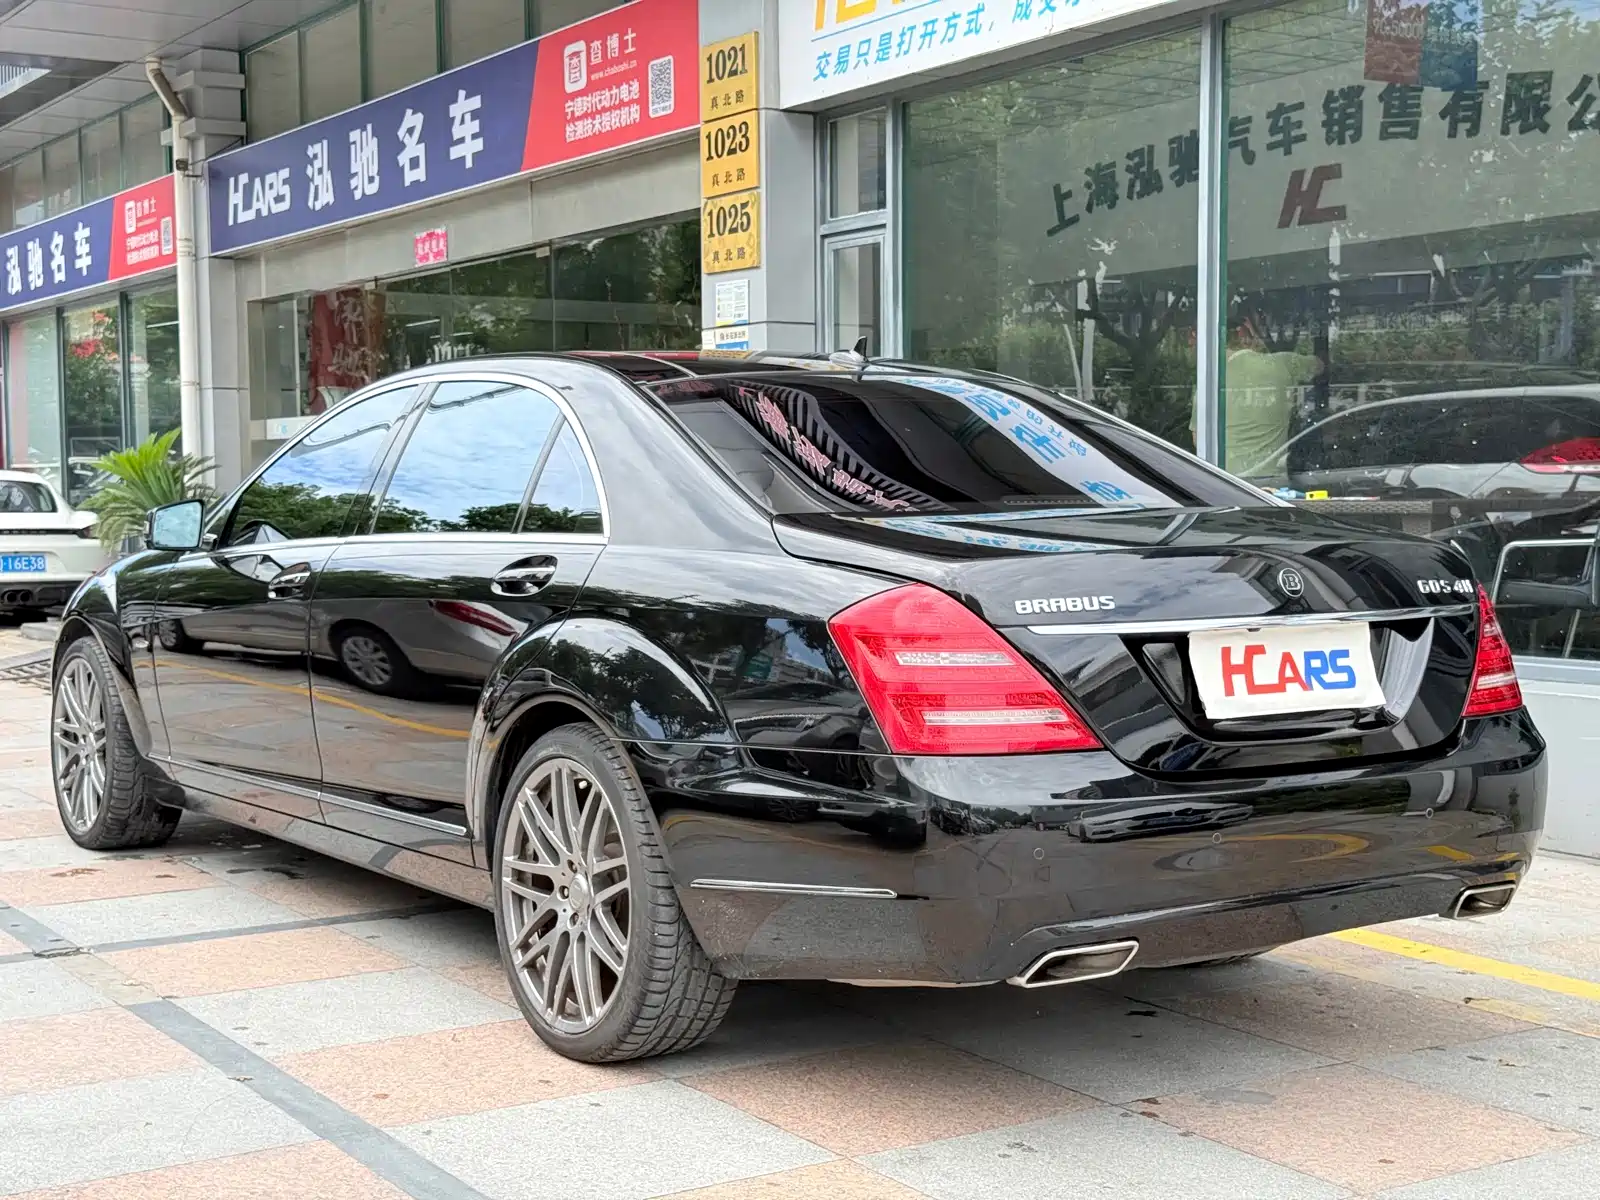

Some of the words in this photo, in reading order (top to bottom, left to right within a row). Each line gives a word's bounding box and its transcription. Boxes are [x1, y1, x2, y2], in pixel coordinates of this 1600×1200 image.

[590, 27, 637, 65] 查博士
[706, 43, 748, 84] 1021
[711, 89, 745, 110] 真北路
[228, 167, 291, 226] HCARS
[305, 88, 485, 212] 泓驰名车
[705, 121, 750, 162] 1023
[711, 168, 746, 188] 真北路
[707, 200, 751, 238] 1025
[6, 221, 92, 295] 泓驰名车
[712, 246, 746, 265] 真北路
[1014, 595, 1116, 615] BRABUS
[1221, 644, 1357, 697] HCARS
